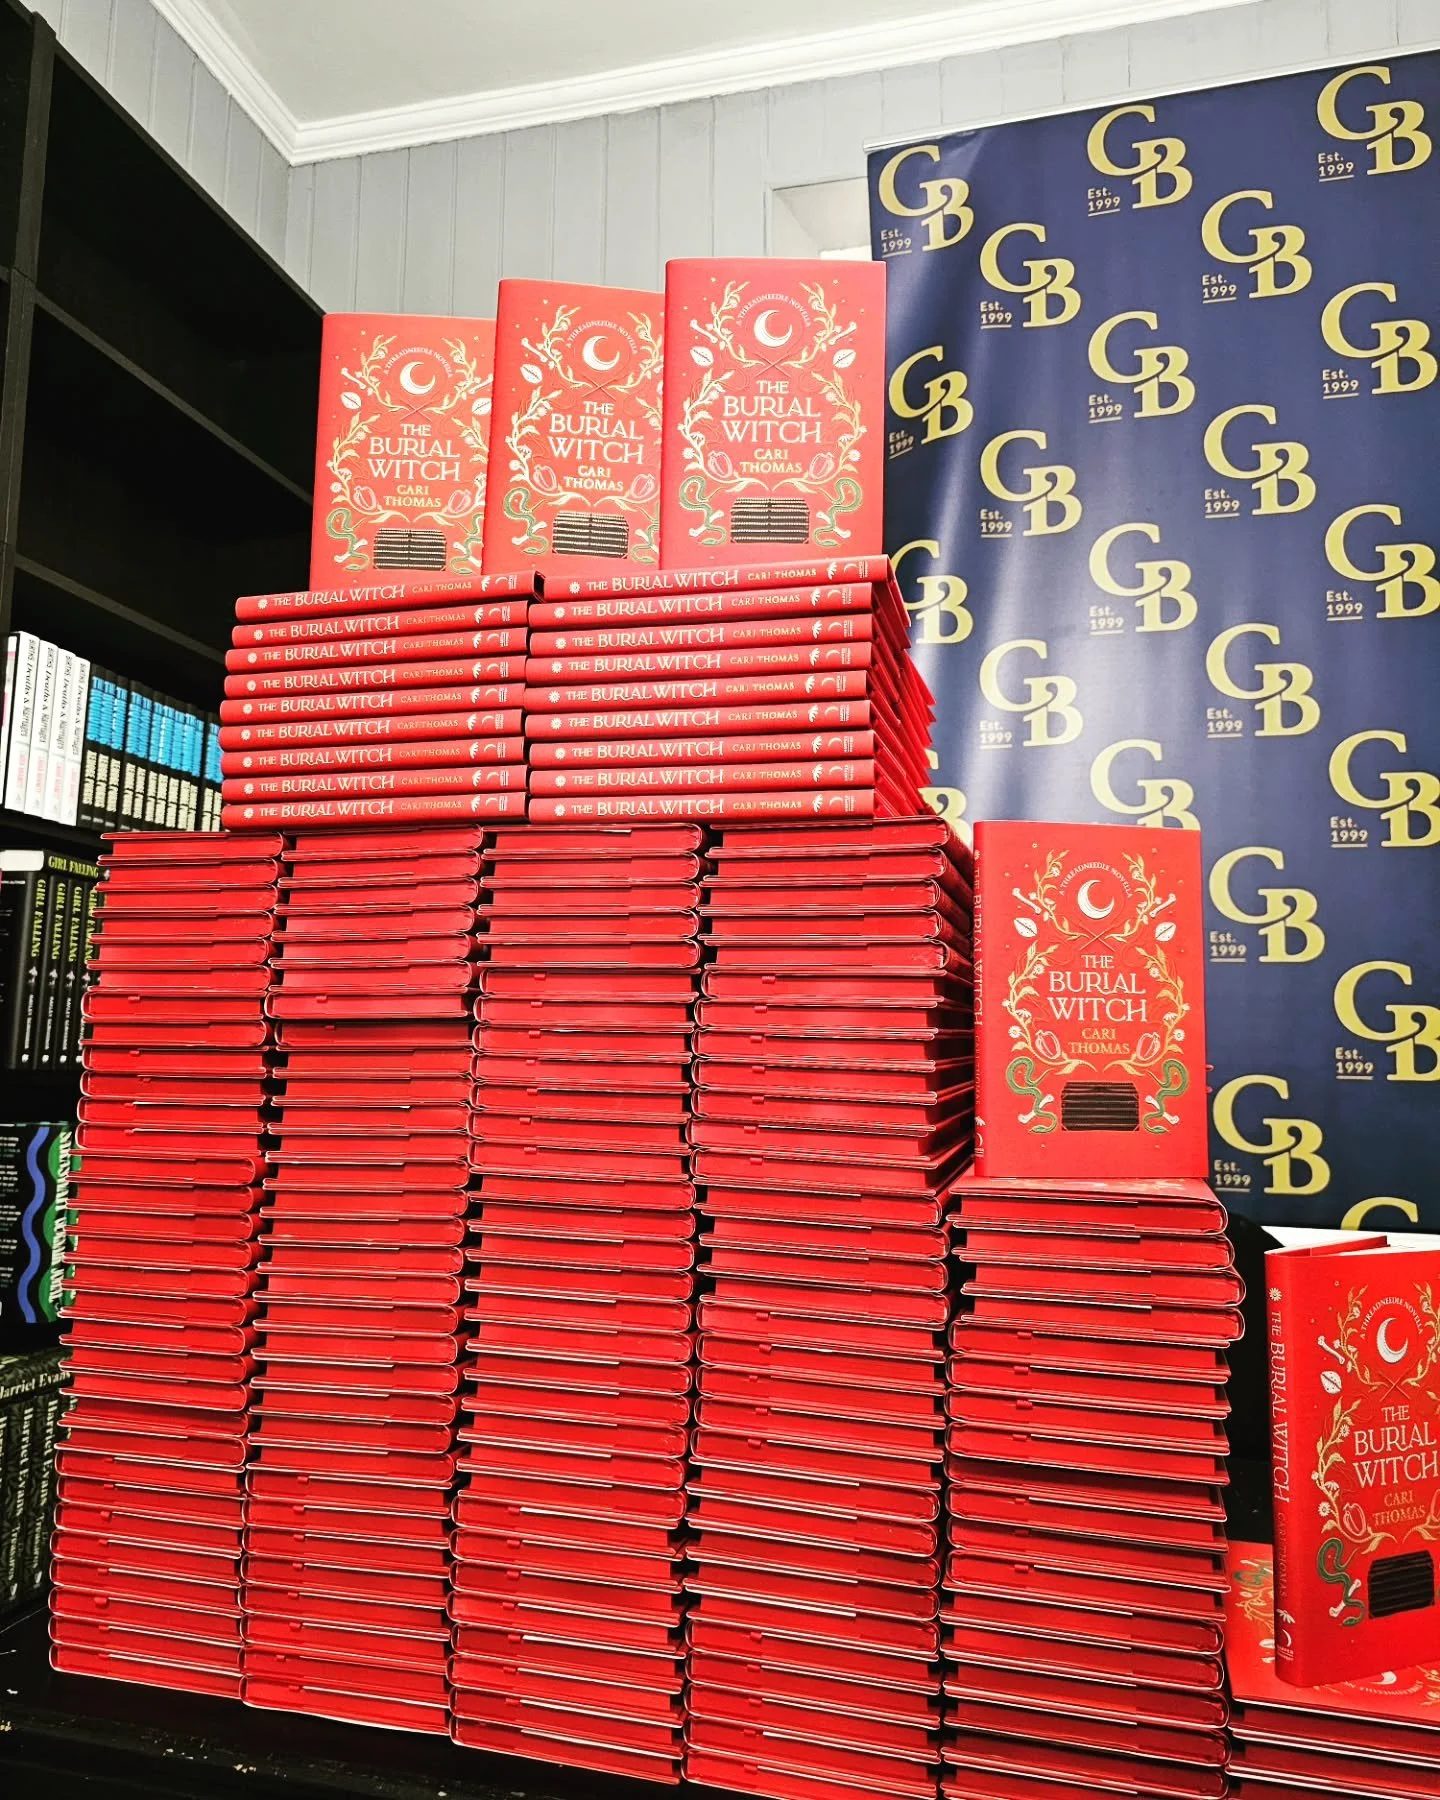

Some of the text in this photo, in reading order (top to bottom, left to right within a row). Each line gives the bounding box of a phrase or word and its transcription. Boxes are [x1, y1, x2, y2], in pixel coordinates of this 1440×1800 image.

[1318, 152, 1344, 164] Est.
[1318, 162, 1354, 176] 1999
[1088, 188, 1111, 199] Est.
[1088, 197, 1121, 212] 1999
[881, 229, 903, 241] Est.
[882, 238, 912, 252] 1999
[1202, 274, 1227, 285] Est.
[1202, 284, 1237, 298] 1999
[1322, 369, 1349, 380] Est.
[756, 380, 789, 394] THE
[1323, 380, 1359, 392] 1999
[584, 401, 614, 416] THE
[723, 396, 821, 418] BURIAL
[400, 424, 432, 436] THE
[550, 414, 644, 440] BURIAL
[722, 420, 822, 443] WITCH
[369, 437, 460, 458] BURIAL
[548, 436, 643, 464] WITCH
[754, 448, 788, 460] CARI
[368, 458, 460, 482] WITCH
[578, 465, 611, 477] CARI
[740, 461, 802, 473] THOMAS
[397, 484, 429, 495] CARI
[564, 476, 623, 492] THOMAS
[1204, 488, 1230, 500] Est.
[384, 496, 442, 508] THOMAS
[1205, 500, 1240, 513] 1999
[980, 509, 1003, 520] Est.
[981, 521, 1013, 533] 1999
[587, 567, 816, 591] THE BURIAL WITCH CARI THOMAS
[274, 581, 472, 606] THE BURIAL WITCH CARI THOMAS
[1326, 591, 1352, 602] Est.
[1327, 603, 1363, 616] 1999
[25, 662, 33, 696] Deaths
[262, 668, 464, 688] THE BURIAL WITCH CARI THOMAS
[43, 670, 52, 702] Deaths
[61, 678, 70, 709] Deaths
[566, 680, 794, 703] THE BURIAL WITCH CARI THOMAS
[76, 685, 84, 716] Deaths
[1207, 708, 1232, 719] Est.
[1207, 720, 1243, 732] 1999
[260, 773, 463, 792] THE BURIAL WITCH CARI THOMAS
[572, 797, 801, 818] THE BURIAL WITCH CARI THOMAS
[1330, 816, 1357, 828] Est.
[1331, 830, 1368, 842] 1999
[48, 856, 98, 878] GIRL FALLING
[1060, 862, 1110, 888] THREADNEEDLE
[1110, 868, 1133, 899] NOVELLA
[31, 879, 46, 957] GIRL FALLING
[52, 882, 66, 960] GIRL FALLING
[69, 886, 82, 962] GIRL FALLING
[1210, 931, 1236, 942] Est.
[1210, 944, 1247, 956] 1999
[1081, 955, 1114, 969] THE
[1050, 971, 1146, 995] BURIAL
[974, 959, 983, 1026] WITCH
[1048, 997, 1147, 1022] WITCH
[1082, 1028, 1116, 1040] CARI
[1068, 1042, 1130, 1054] THOMAS
[1336, 1048, 1363, 1059] Est.
[1336, 1061, 1373, 1074] 1999
[1214, 1160, 1241, 1172] Est.
[1215, 1174, 1251, 1185] 1999
[1361, 1297, 1403, 1330] THREADNEEDLE
[1404, 1300, 1423, 1336] NOVELLA
[1381, 1404, 1410, 1422] THE
[1354, 1422, 1436, 1456] BURIAL
[40, 1400, 58, 1506] Harriet Evans
[1270, 1311, 1290, 1599] THE BURIAL WITCH CARI THOMAS
[16, 1408, 34, 1516] Harriet Evans
[1352, 1451, 1439, 1488] WITCH
[1384, 1490, 1413, 1507] CARI
[1372, 1506, 1426, 1526] THOMAS
